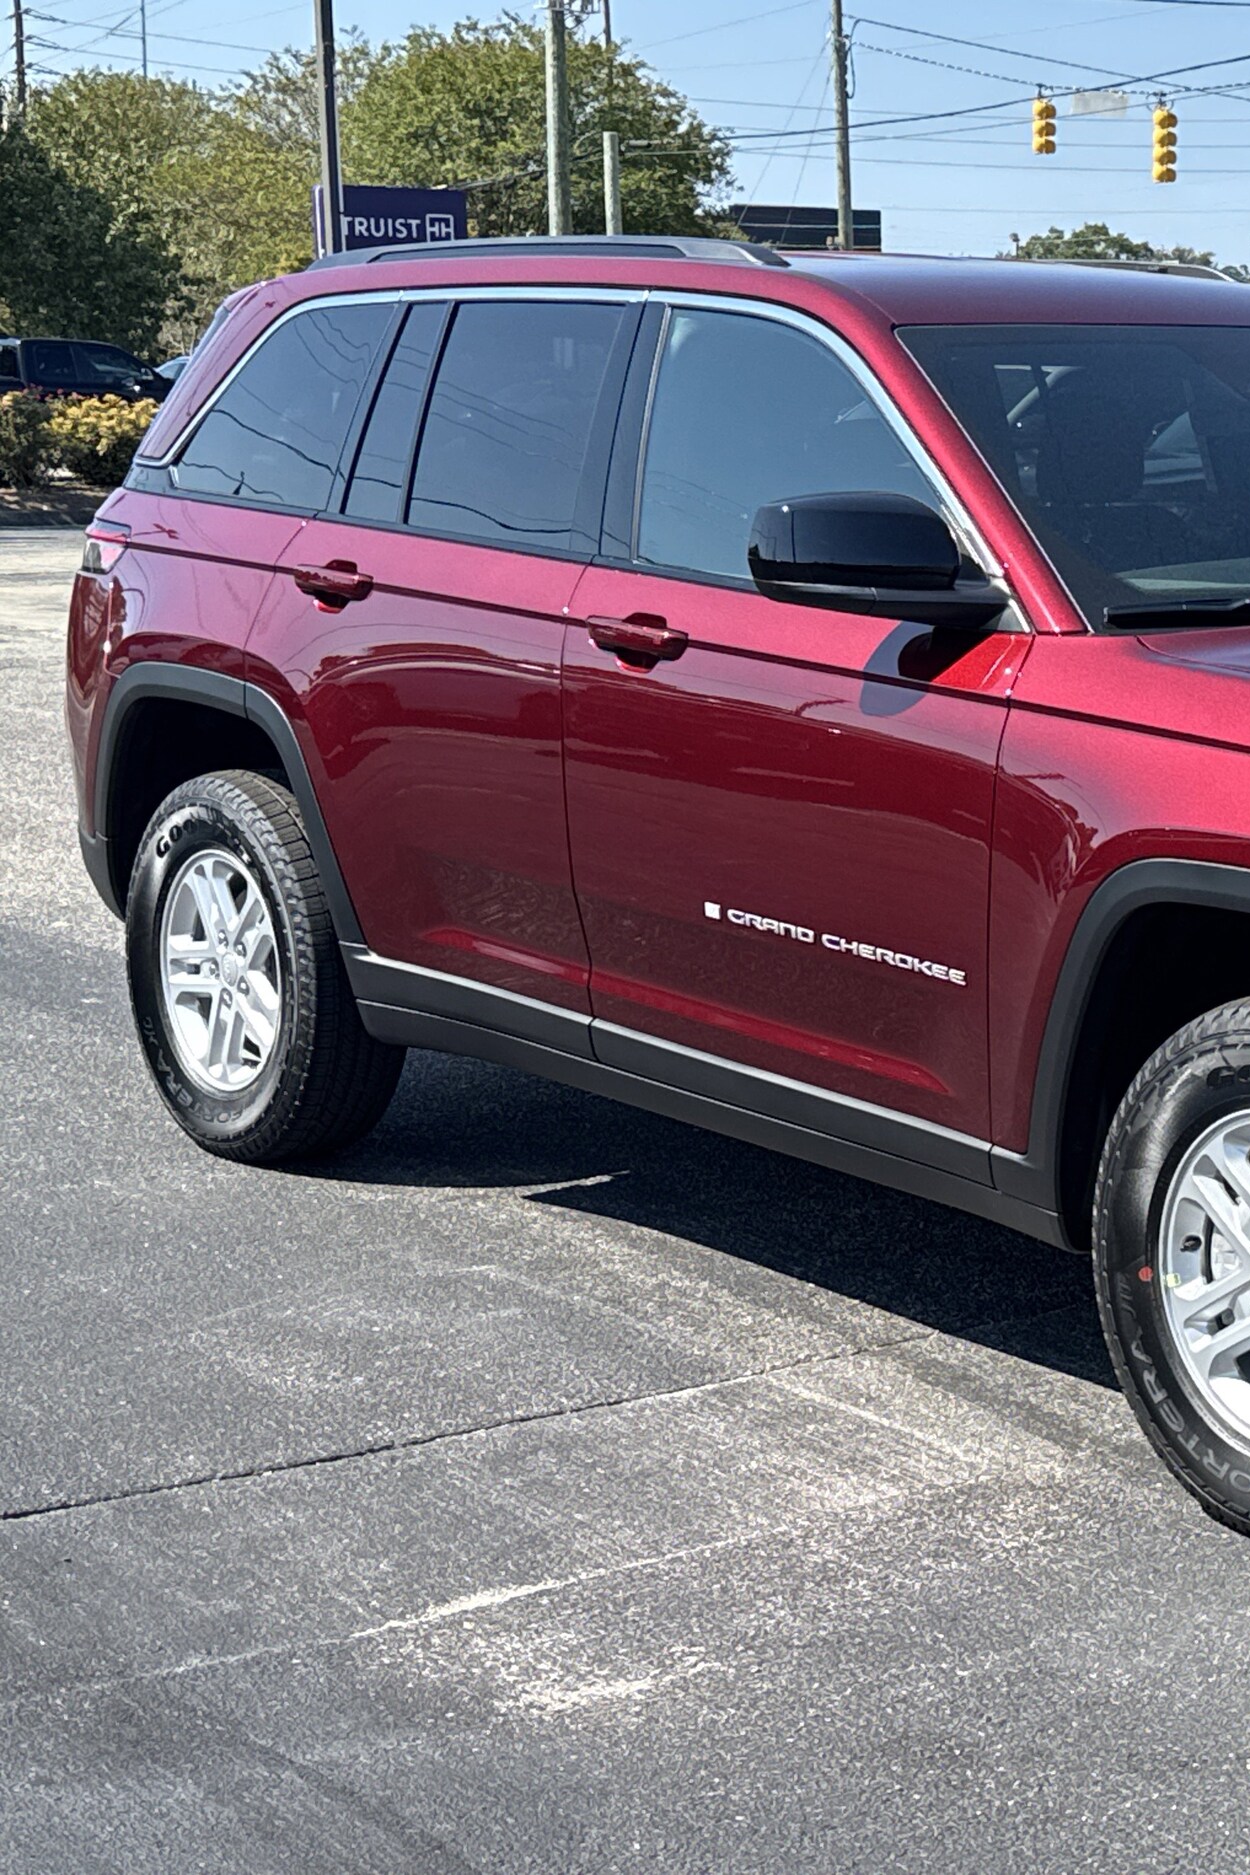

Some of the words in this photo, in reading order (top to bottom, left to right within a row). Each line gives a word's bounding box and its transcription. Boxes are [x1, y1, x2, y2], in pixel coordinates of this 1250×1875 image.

[343, 216, 421, 239] TRUIST
[727, 908, 815, 943] GRAND
[821, 933, 967, 986] CHEROKEE
